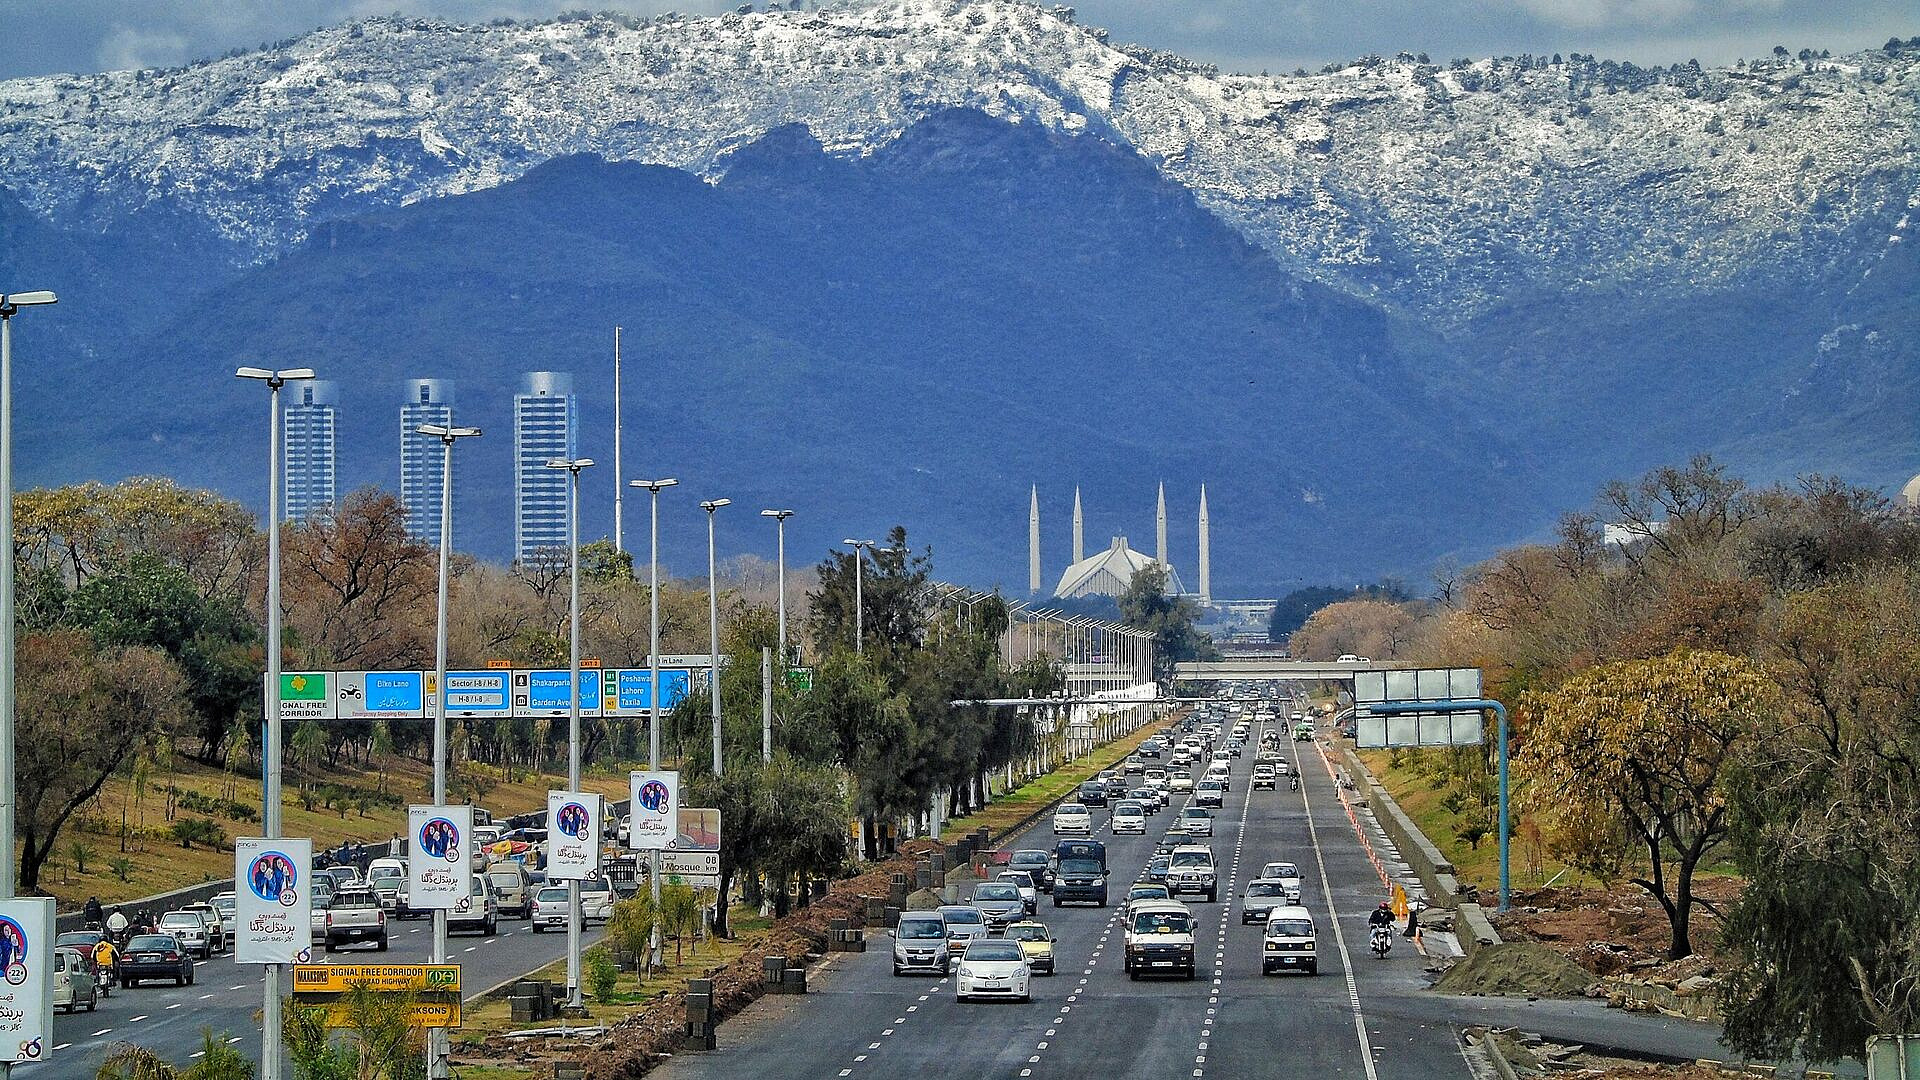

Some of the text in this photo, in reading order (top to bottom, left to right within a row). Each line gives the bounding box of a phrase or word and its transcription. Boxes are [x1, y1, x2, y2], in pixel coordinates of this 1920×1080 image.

[330, 968, 359, 976] SIGNAL
[361, 968, 380, 976] FREE
[382, 968, 423, 977] CORRIDOR
